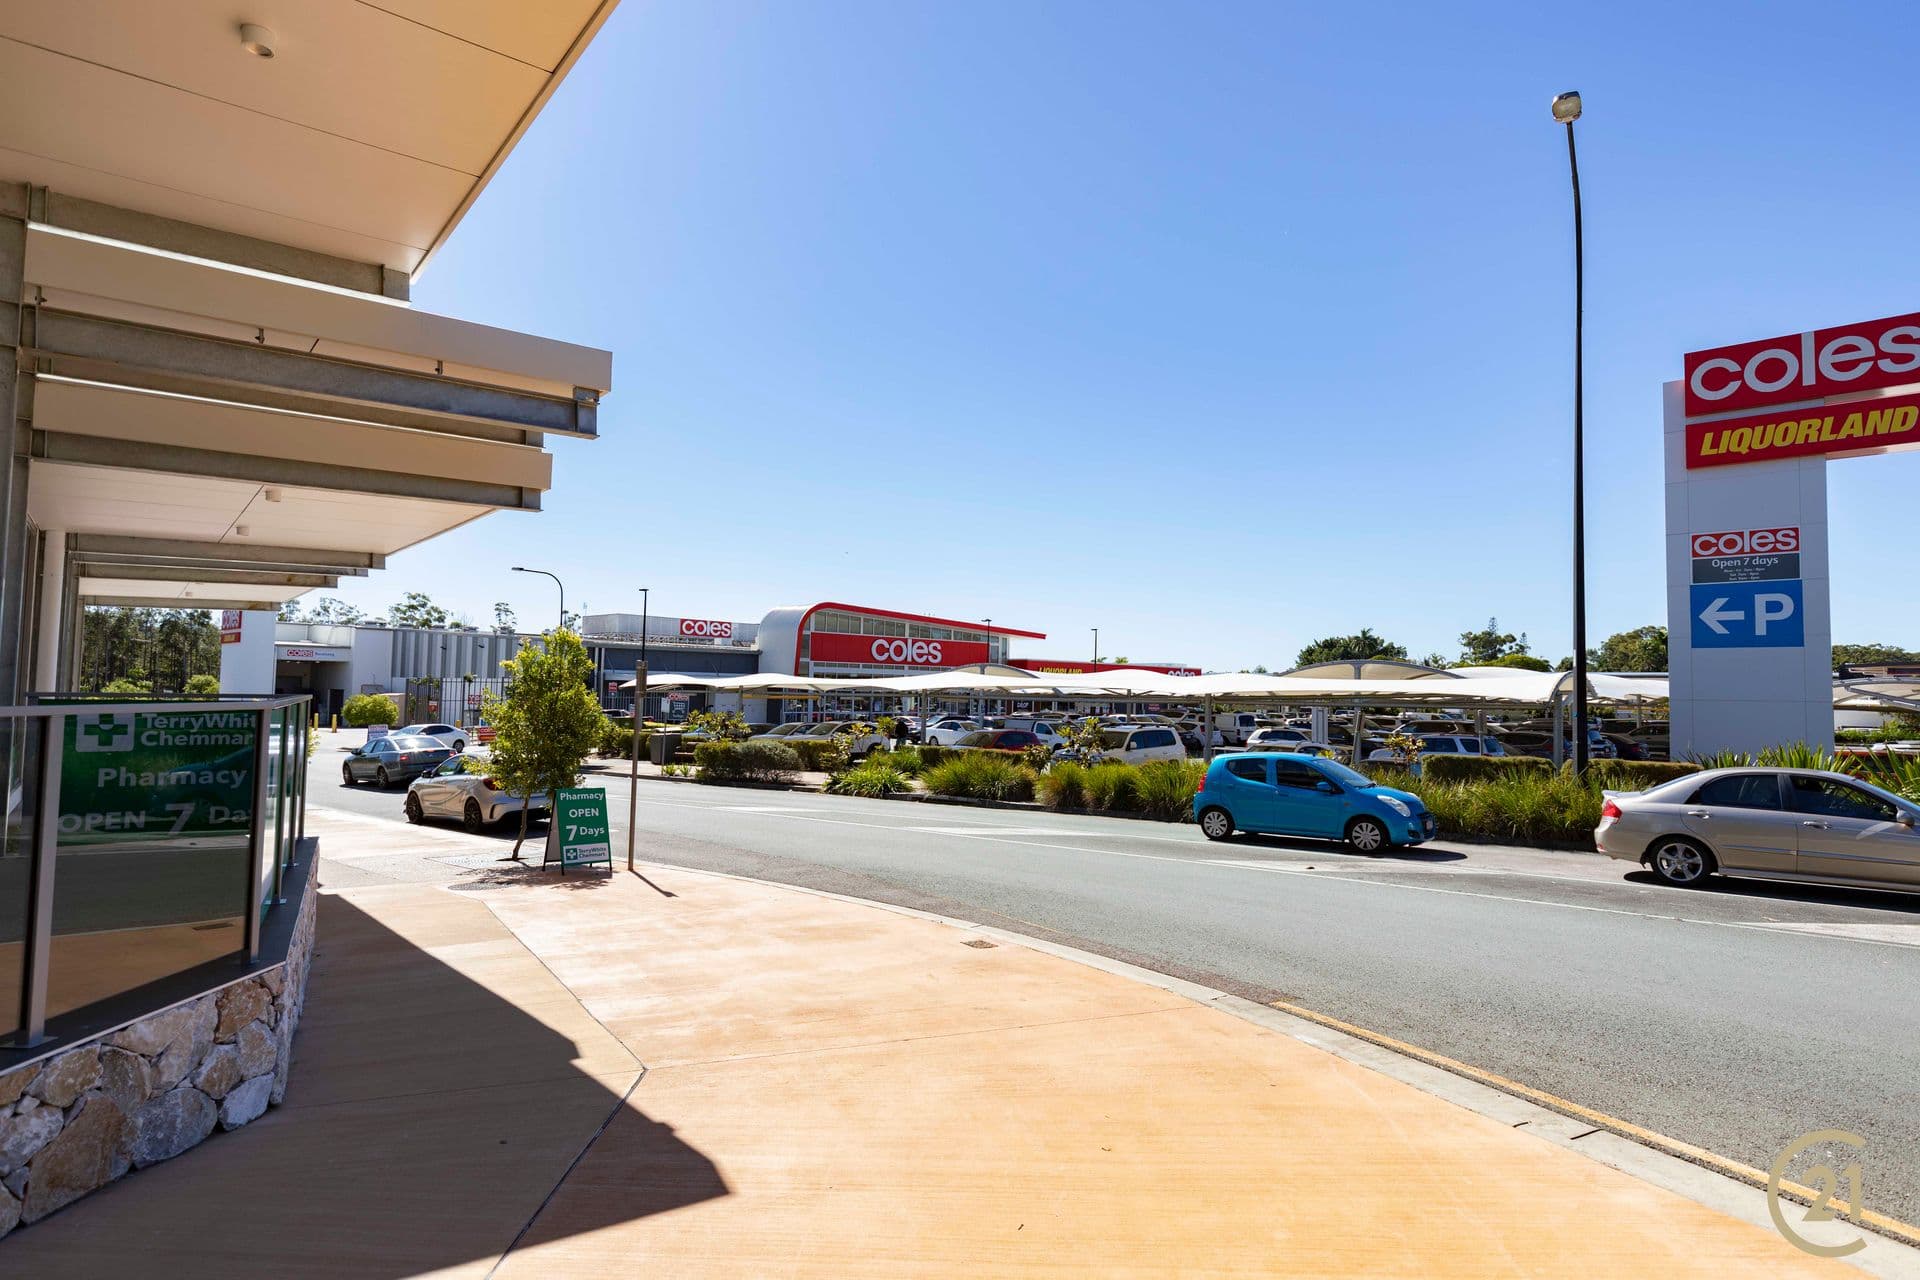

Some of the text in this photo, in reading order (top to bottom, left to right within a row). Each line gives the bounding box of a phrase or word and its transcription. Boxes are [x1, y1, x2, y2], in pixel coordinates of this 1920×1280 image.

[1690, 330, 1920, 401] coles
[1700, 405, 1919, 456] LIQUORLAND
[1693, 529, 1798, 556] coles
[1711, 559, 1741, 570] Open
[1743, 557, 1750, 566] 7
[1752, 556, 1779, 567] days
[1754, 592, 1795, 636] P
[681, 619, 732, 638] coles
[871, 638, 942, 664] coles
[97, 767, 248, 788] Pharmacy
[560, 792, 604, 801] Pharmacy
[58, 810, 146, 833] OPEN
[165, 803, 195, 836] 7
[568, 807, 599, 818] OPEN
[565, 824, 605, 841] 7 Days
